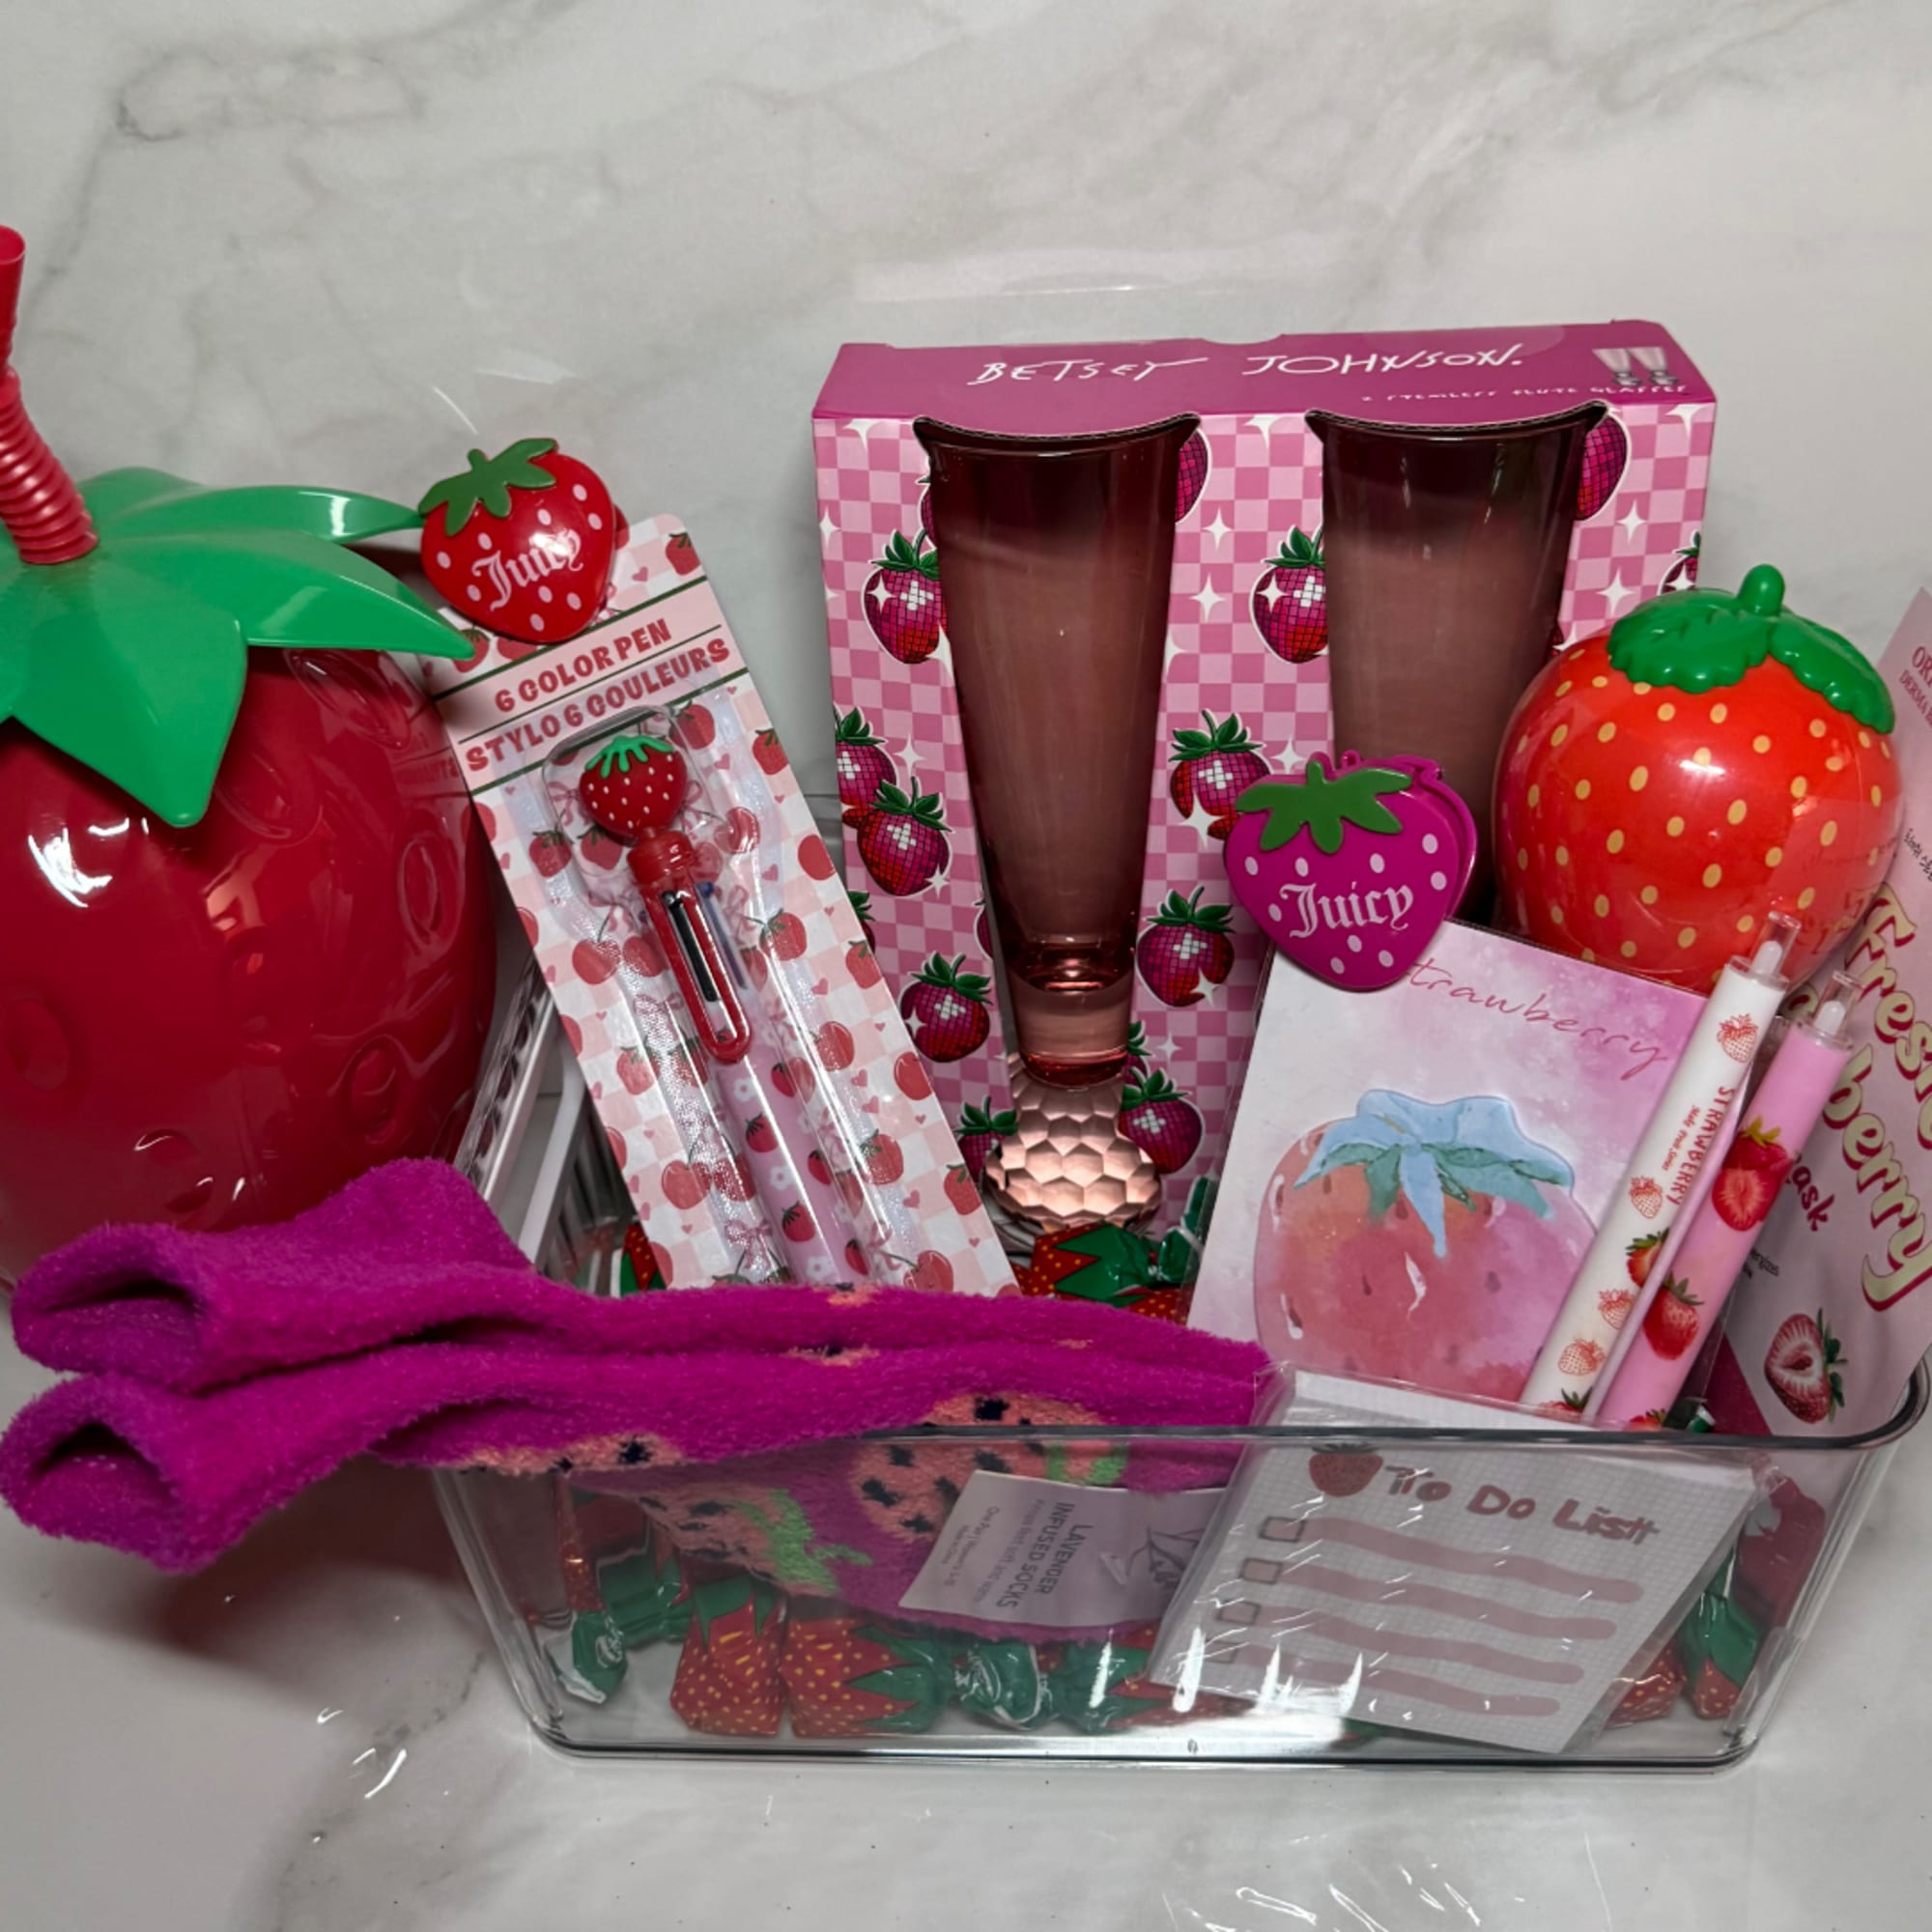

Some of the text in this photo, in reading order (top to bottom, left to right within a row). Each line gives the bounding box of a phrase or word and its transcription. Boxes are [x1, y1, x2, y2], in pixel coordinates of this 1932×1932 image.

[967, 356, 1208, 385] BETSEY
[1512, 387, 1577, 396] FLUTE
[1589, 384, 1688, 395] GLASSES
[494, 617, 672, 713] 6 COLOR PEN
[465, 638, 730, 772] STYLO 6 COULEURS
[1279, 881, 1414, 939] Juicy
[1406, 957, 1668, 1082] trawberry
[1665, 1086, 1736, 1206] STRAWBERRY
[1783, 1156, 1834, 1233] ask
[1028, 1501, 1075, 1562] INFUSED
[1385, 1463, 1661, 1546] To Do List
[996, 1562, 1037, 1608] SOCKS
[1034, 1523, 1094, 1595] LAVENDER
